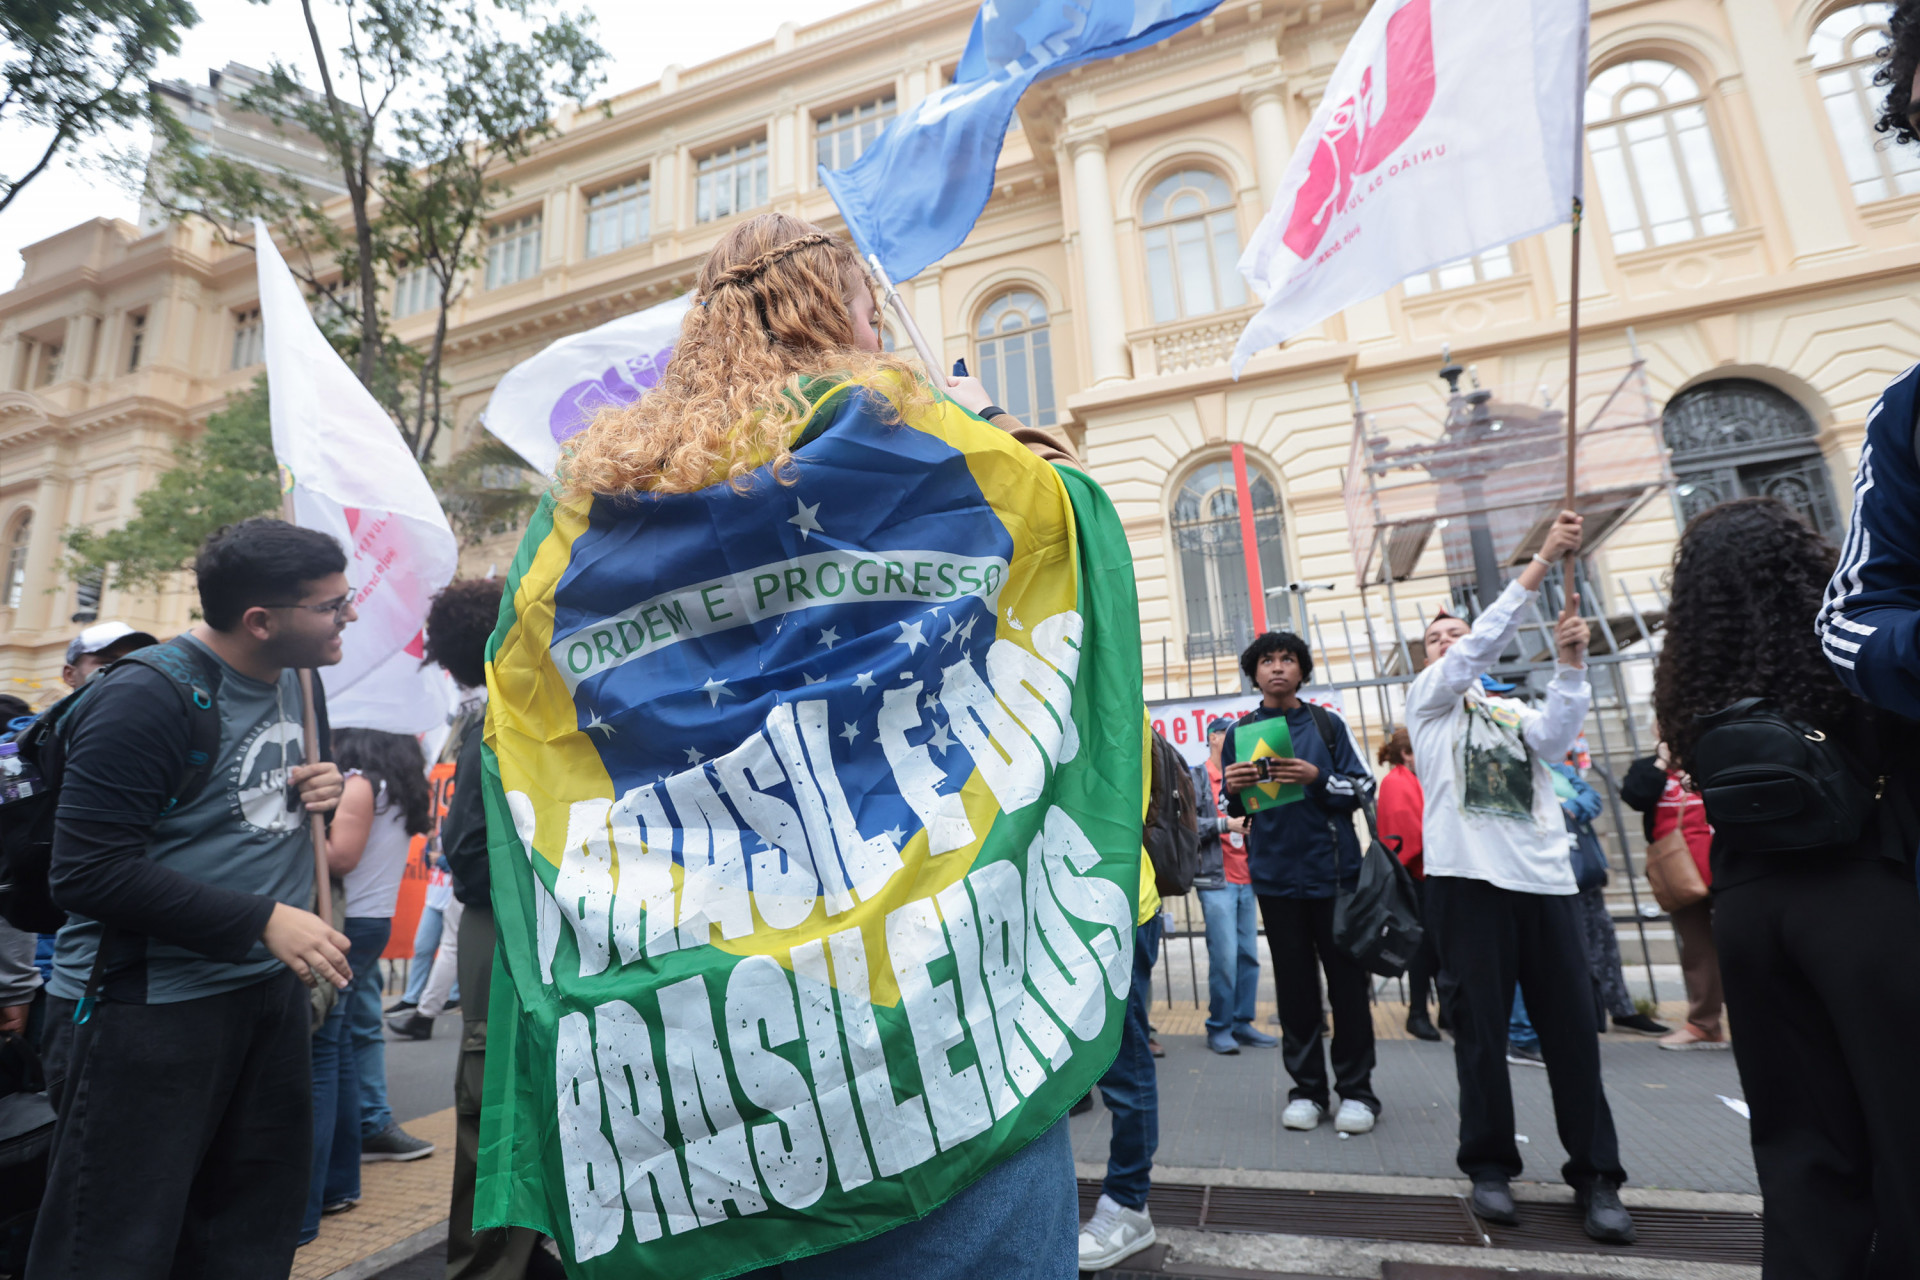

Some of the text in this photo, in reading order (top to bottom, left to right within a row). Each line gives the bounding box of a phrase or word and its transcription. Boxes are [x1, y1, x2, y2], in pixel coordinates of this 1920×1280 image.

[568, 560, 1002, 676] ORDEM E PROGRESSO
[239, 720, 271, 753] UNIÃO
[1172, 716, 1188, 745] e
[555, 699, 904, 977] BRASIL
[877, 672, 976, 856] É
[941, 609, 1084, 816] DOS
[556, 804, 1132, 1263] BRASILEIROS
